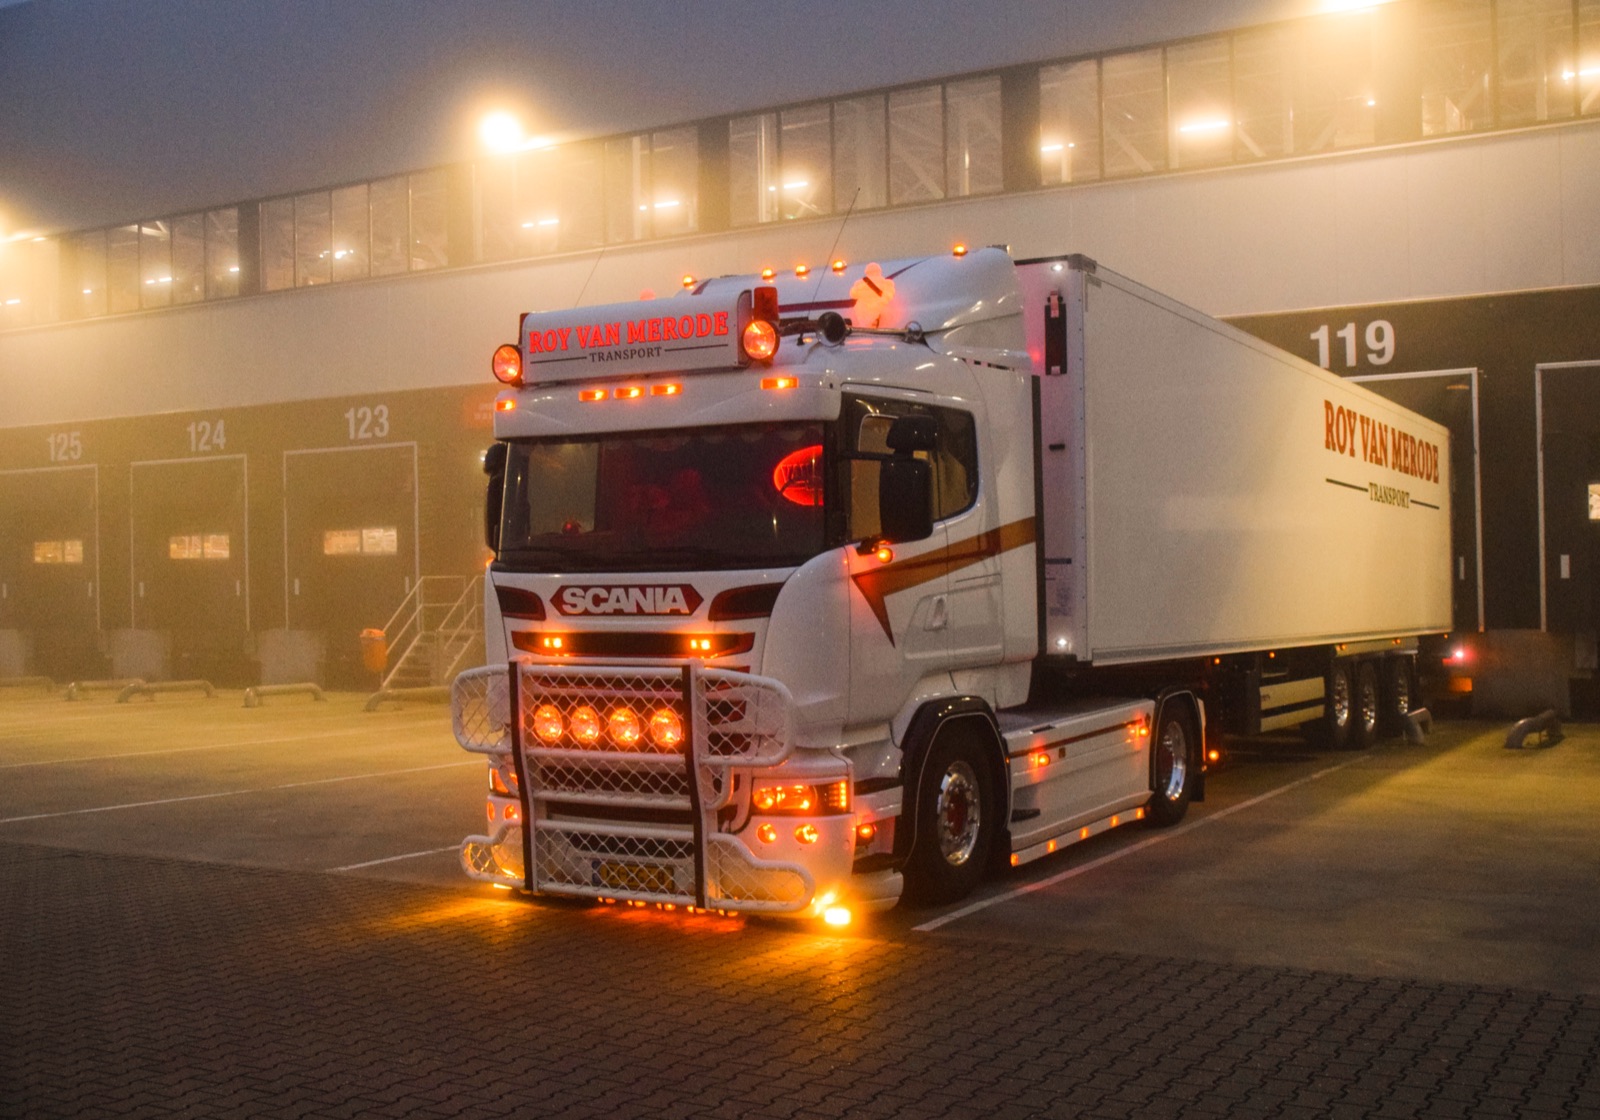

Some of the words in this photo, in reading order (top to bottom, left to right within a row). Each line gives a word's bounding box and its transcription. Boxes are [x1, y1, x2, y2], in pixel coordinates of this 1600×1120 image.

[529, 326, 572, 354] ROY
[575, 321, 621, 349] VAN
[626, 311, 729, 344] MERODE
[1310, 319, 1396, 369] 119
[589, 346, 663, 363] TRANSPORT
[187, 419, 227, 452] 124
[345, 404, 390, 440] 123
[47, 431, 83, 462] 125
[1324, 399, 1357, 458] ROY
[1359, 413, 1389, 469] VAN
[1391, 426, 1440, 485] MERODE
[1368, 482, 1411, 509] TRANSPORT
[562, 586, 691, 615] SCANIA
